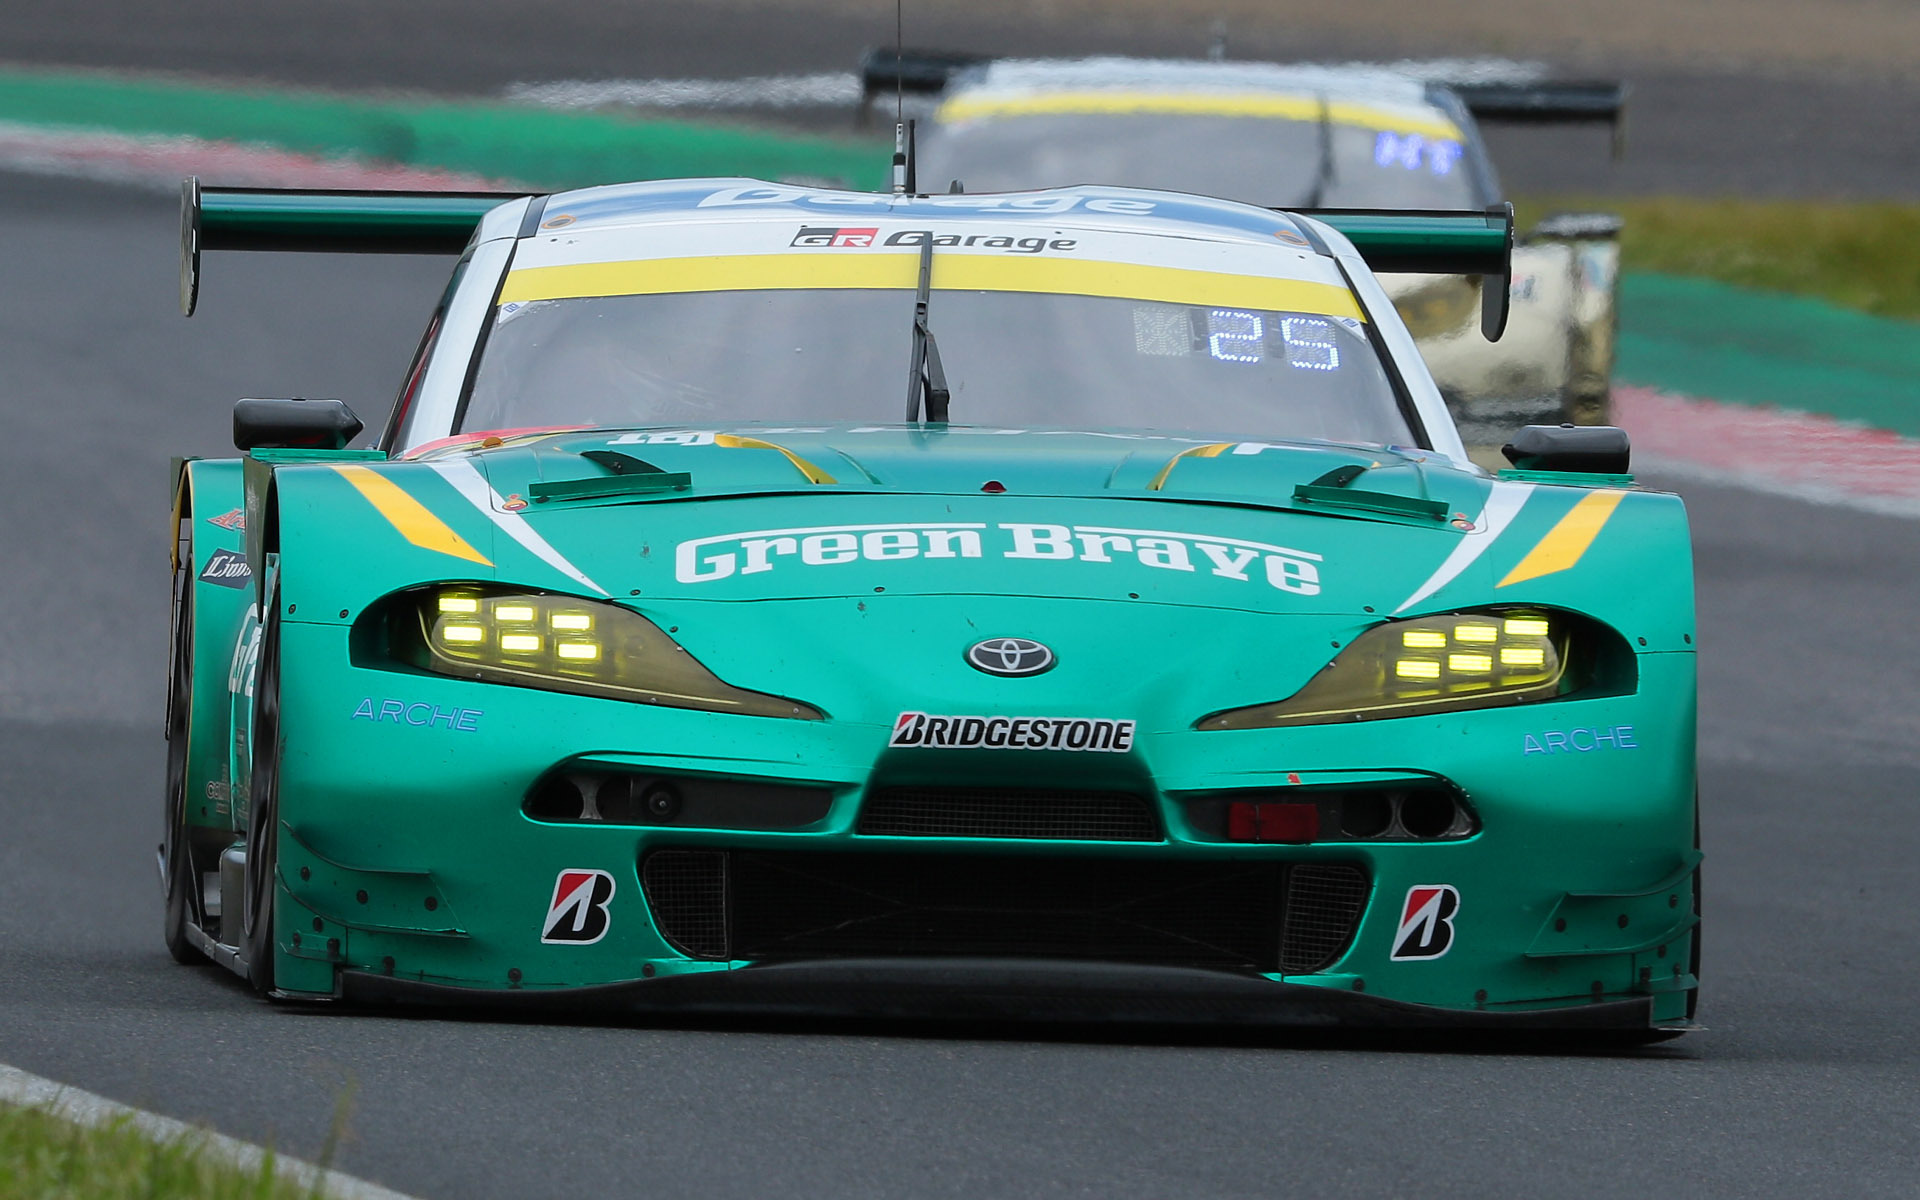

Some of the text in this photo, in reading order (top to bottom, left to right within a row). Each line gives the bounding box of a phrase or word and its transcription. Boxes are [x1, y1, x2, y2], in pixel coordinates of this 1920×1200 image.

[791, 231, 1077, 254] GR Garage
[676, 523, 1323, 596] Green Brave
[352, 698, 484, 732] ARCHE
[891, 713, 1132, 750] BRIDGESTONE
[1524, 725, 1638, 755] ARCHE
